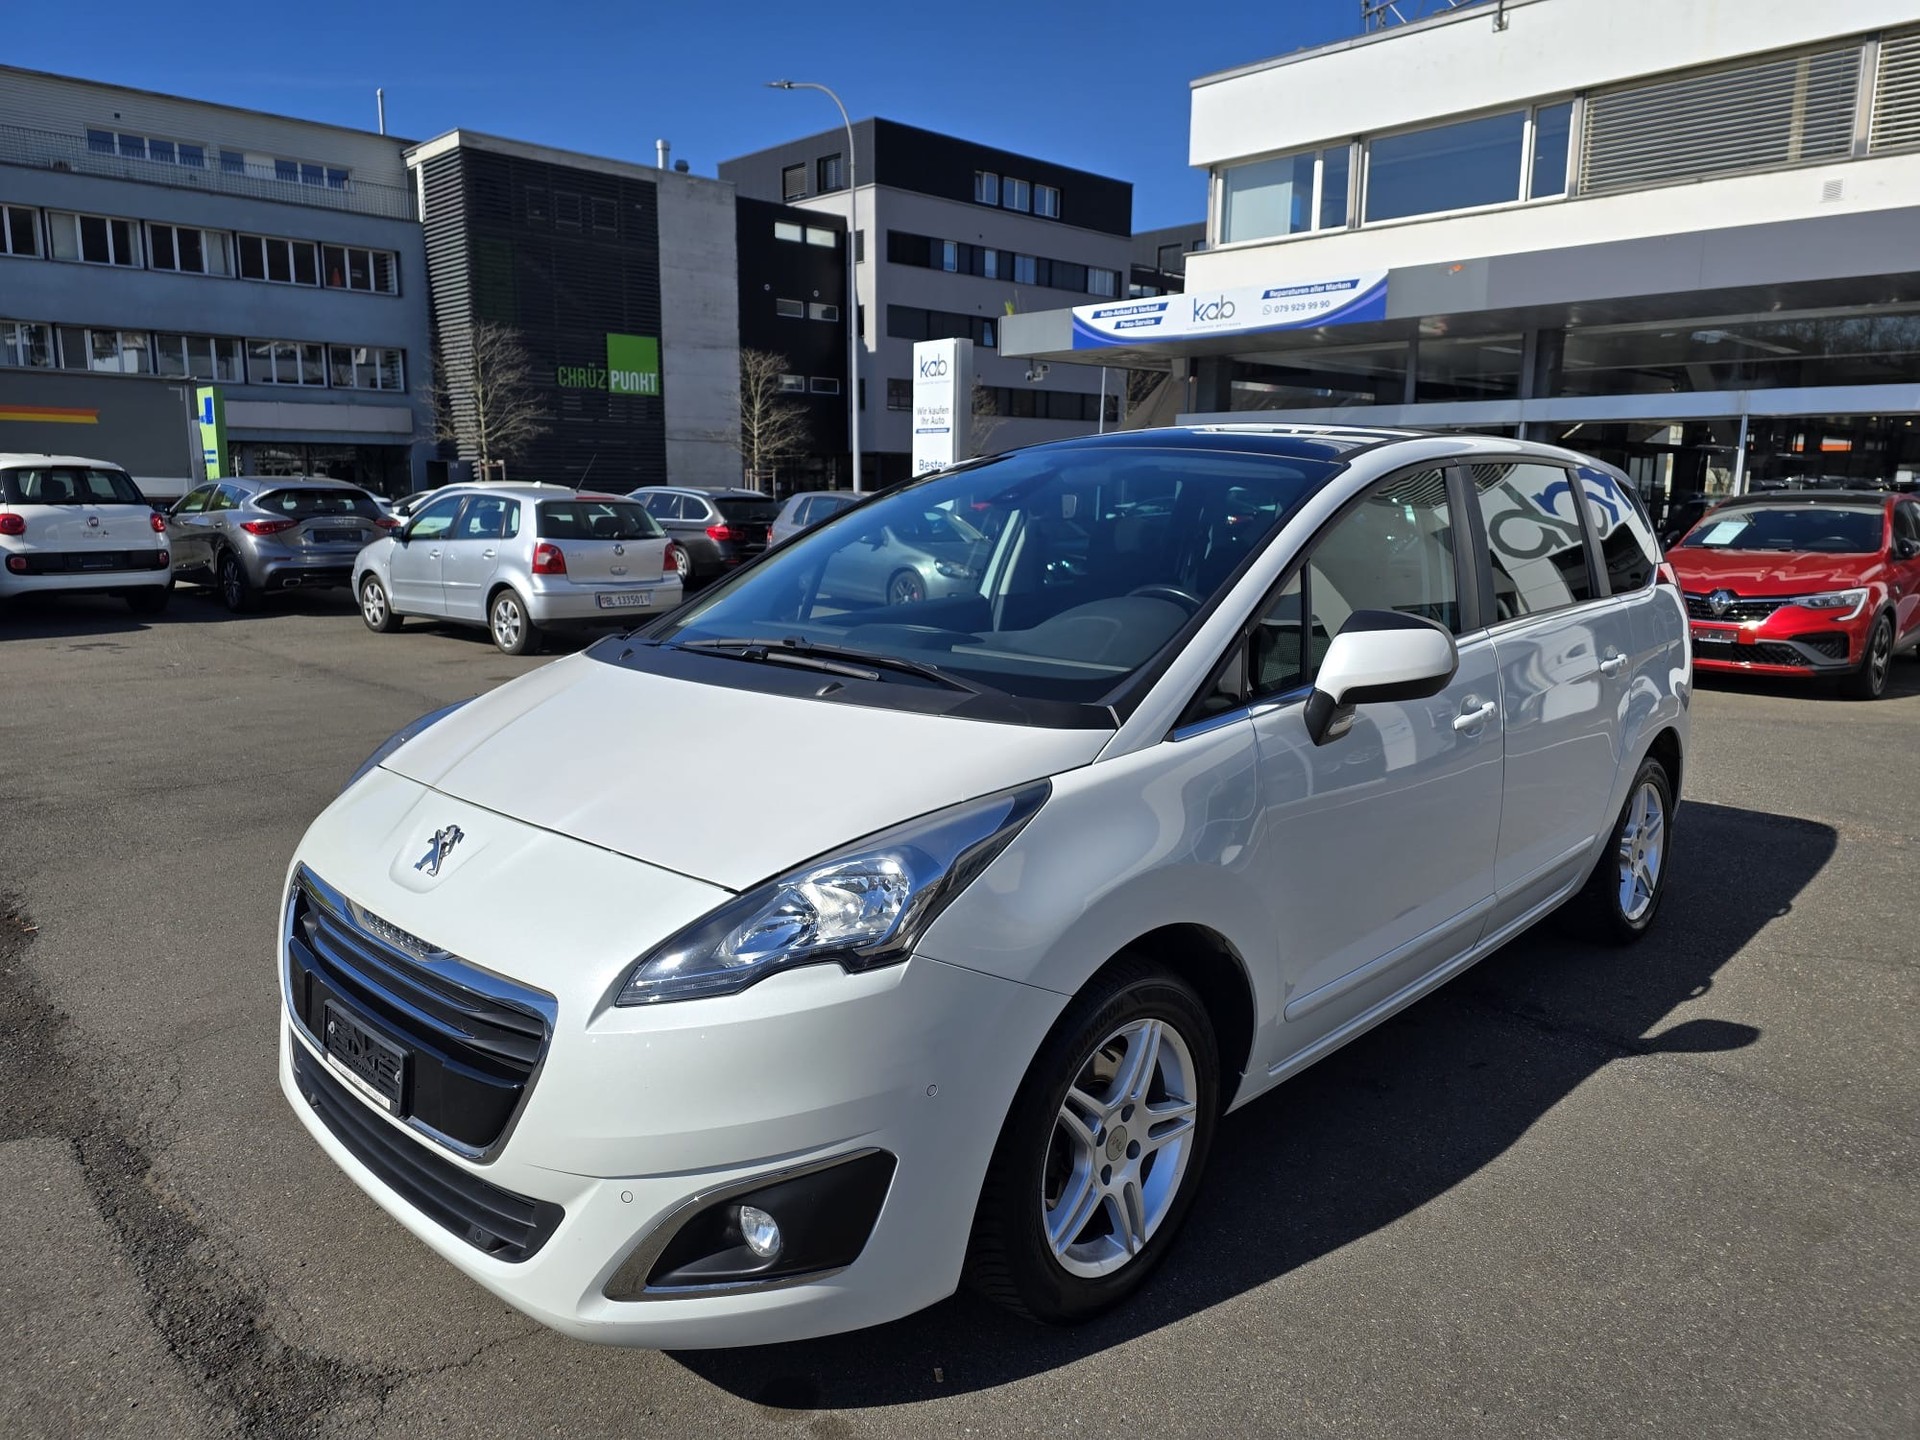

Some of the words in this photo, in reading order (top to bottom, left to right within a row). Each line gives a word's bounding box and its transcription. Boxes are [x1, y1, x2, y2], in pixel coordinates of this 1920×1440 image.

[1269, 287, 1310, 298] Reparaturen
[1310, 285, 1325, 293] aller
[1325, 282, 1352, 291] Marken
[1192, 294, 1236, 323] kab
[1274, 305, 1290, 313] 079
[1291, 303, 1306, 311] 929
[1307, 302, 1318, 310] 99
[1319, 300, 1331, 309] 90
[919, 353, 948, 379] kab
[557, 362, 607, 390] CHRÜZ
[610, 369, 657, 393] PUNKT
[916, 406, 927, 416] Wir
[928, 404, 950, 415] kaufen
[930, 415, 945, 425] Auto
